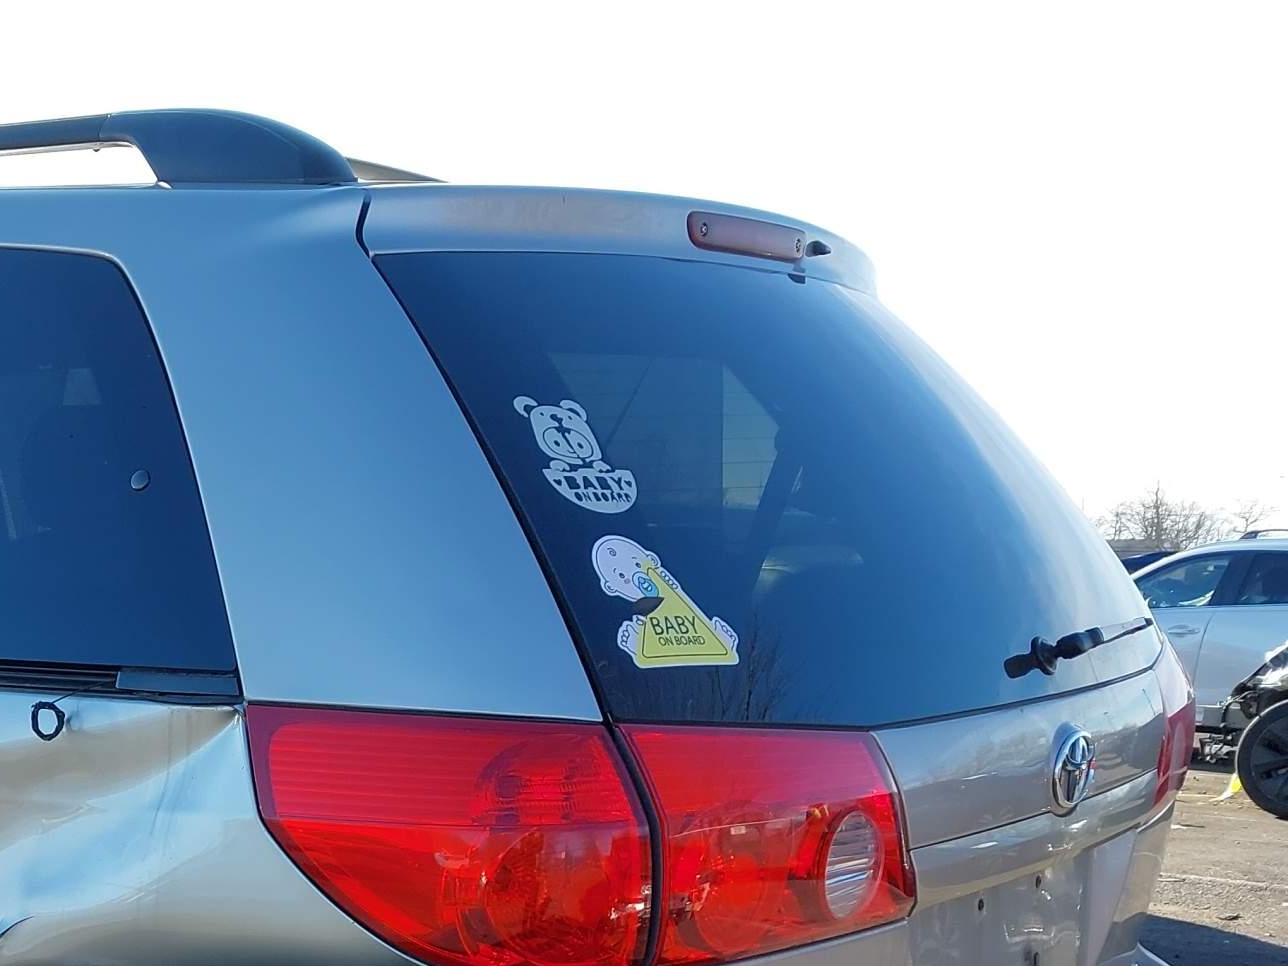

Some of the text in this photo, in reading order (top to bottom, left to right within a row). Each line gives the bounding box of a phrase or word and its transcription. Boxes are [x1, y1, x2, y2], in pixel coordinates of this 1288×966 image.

[563, 475, 625, 491] BABY
[573, 491, 593, 502] ON
[649, 615, 698, 636] BABY
[658, 635, 706, 647] ON BOARD
